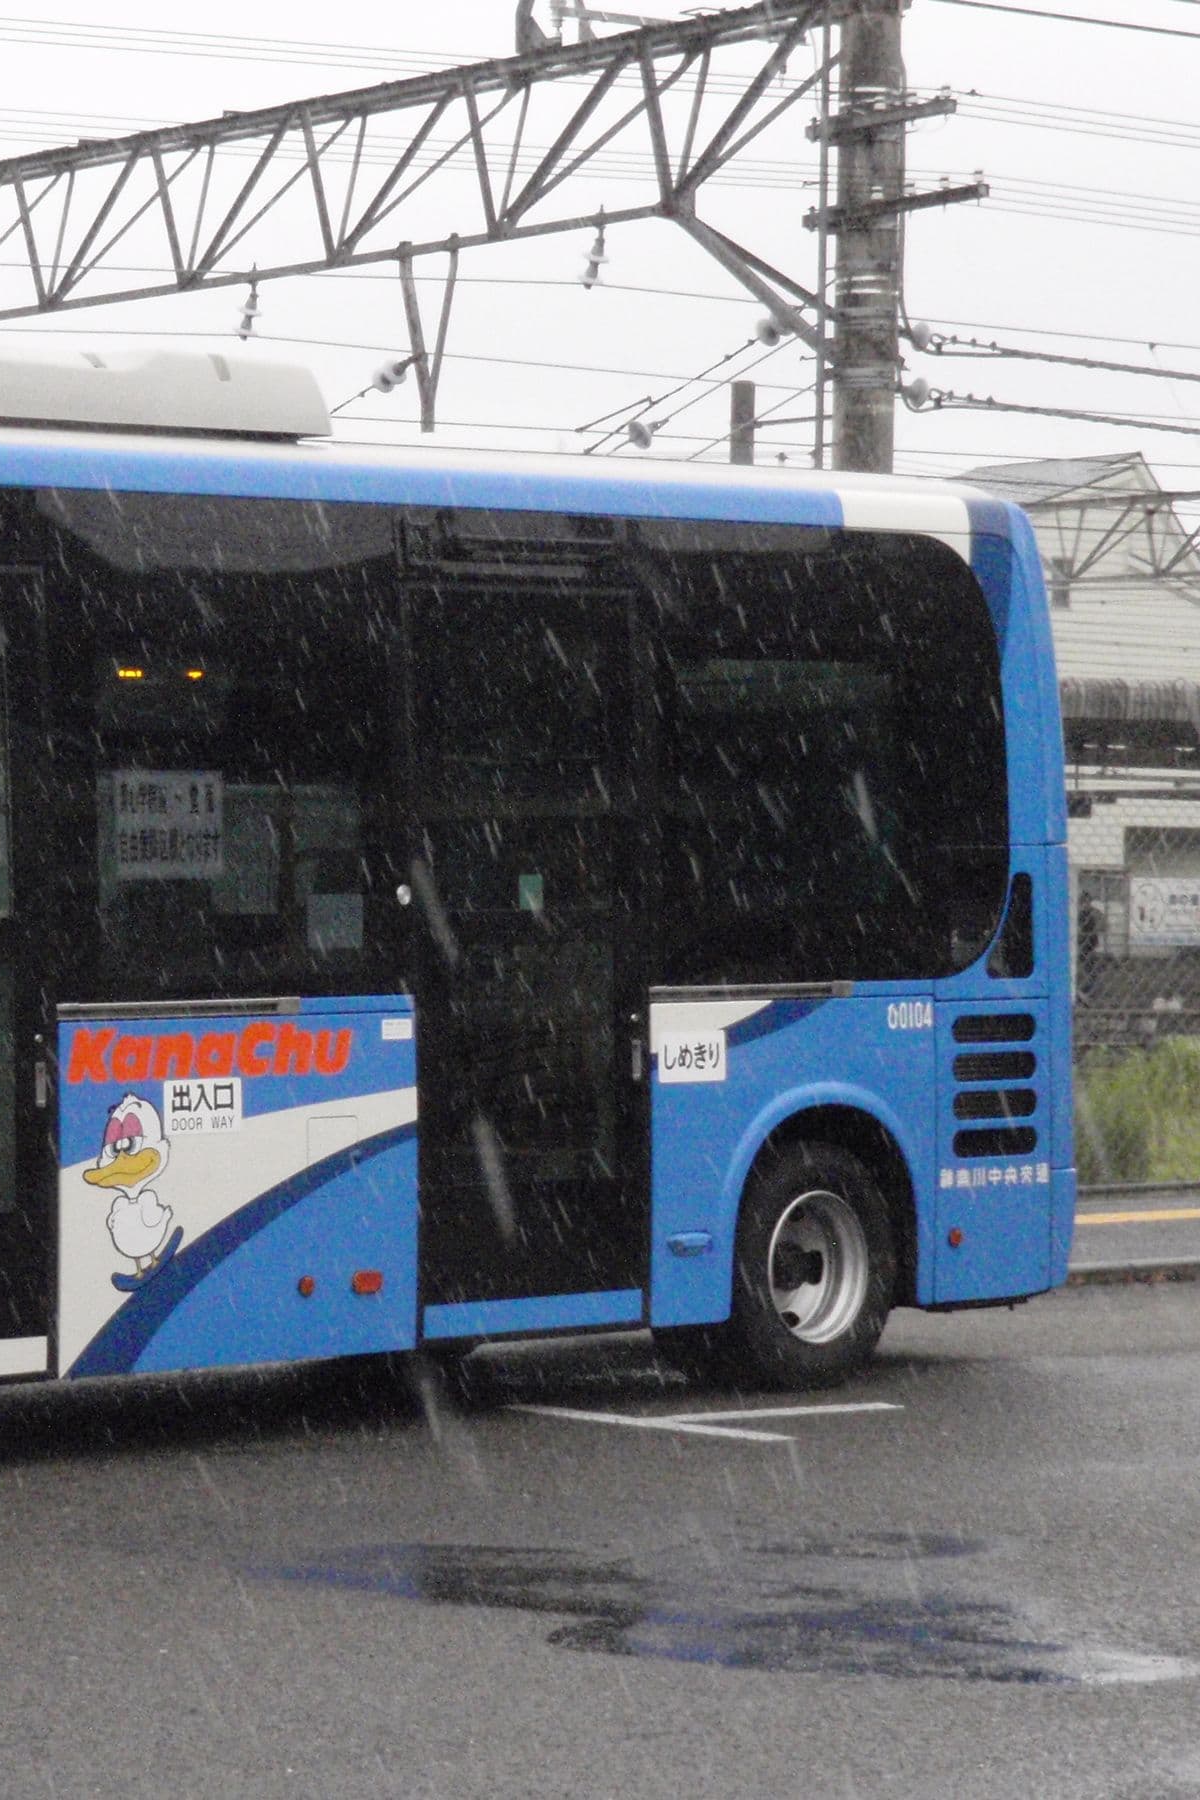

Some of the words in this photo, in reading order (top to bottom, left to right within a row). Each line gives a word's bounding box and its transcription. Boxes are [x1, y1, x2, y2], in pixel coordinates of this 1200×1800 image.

[66, 1020, 353, 1085] KanaChu
[663, 1042, 720, 1070] しめきり
[171, 1083, 235, 1113] 出入口
[171, 1117, 204, 1132] DOOR
[211, 1115, 236, 1130] WAY
